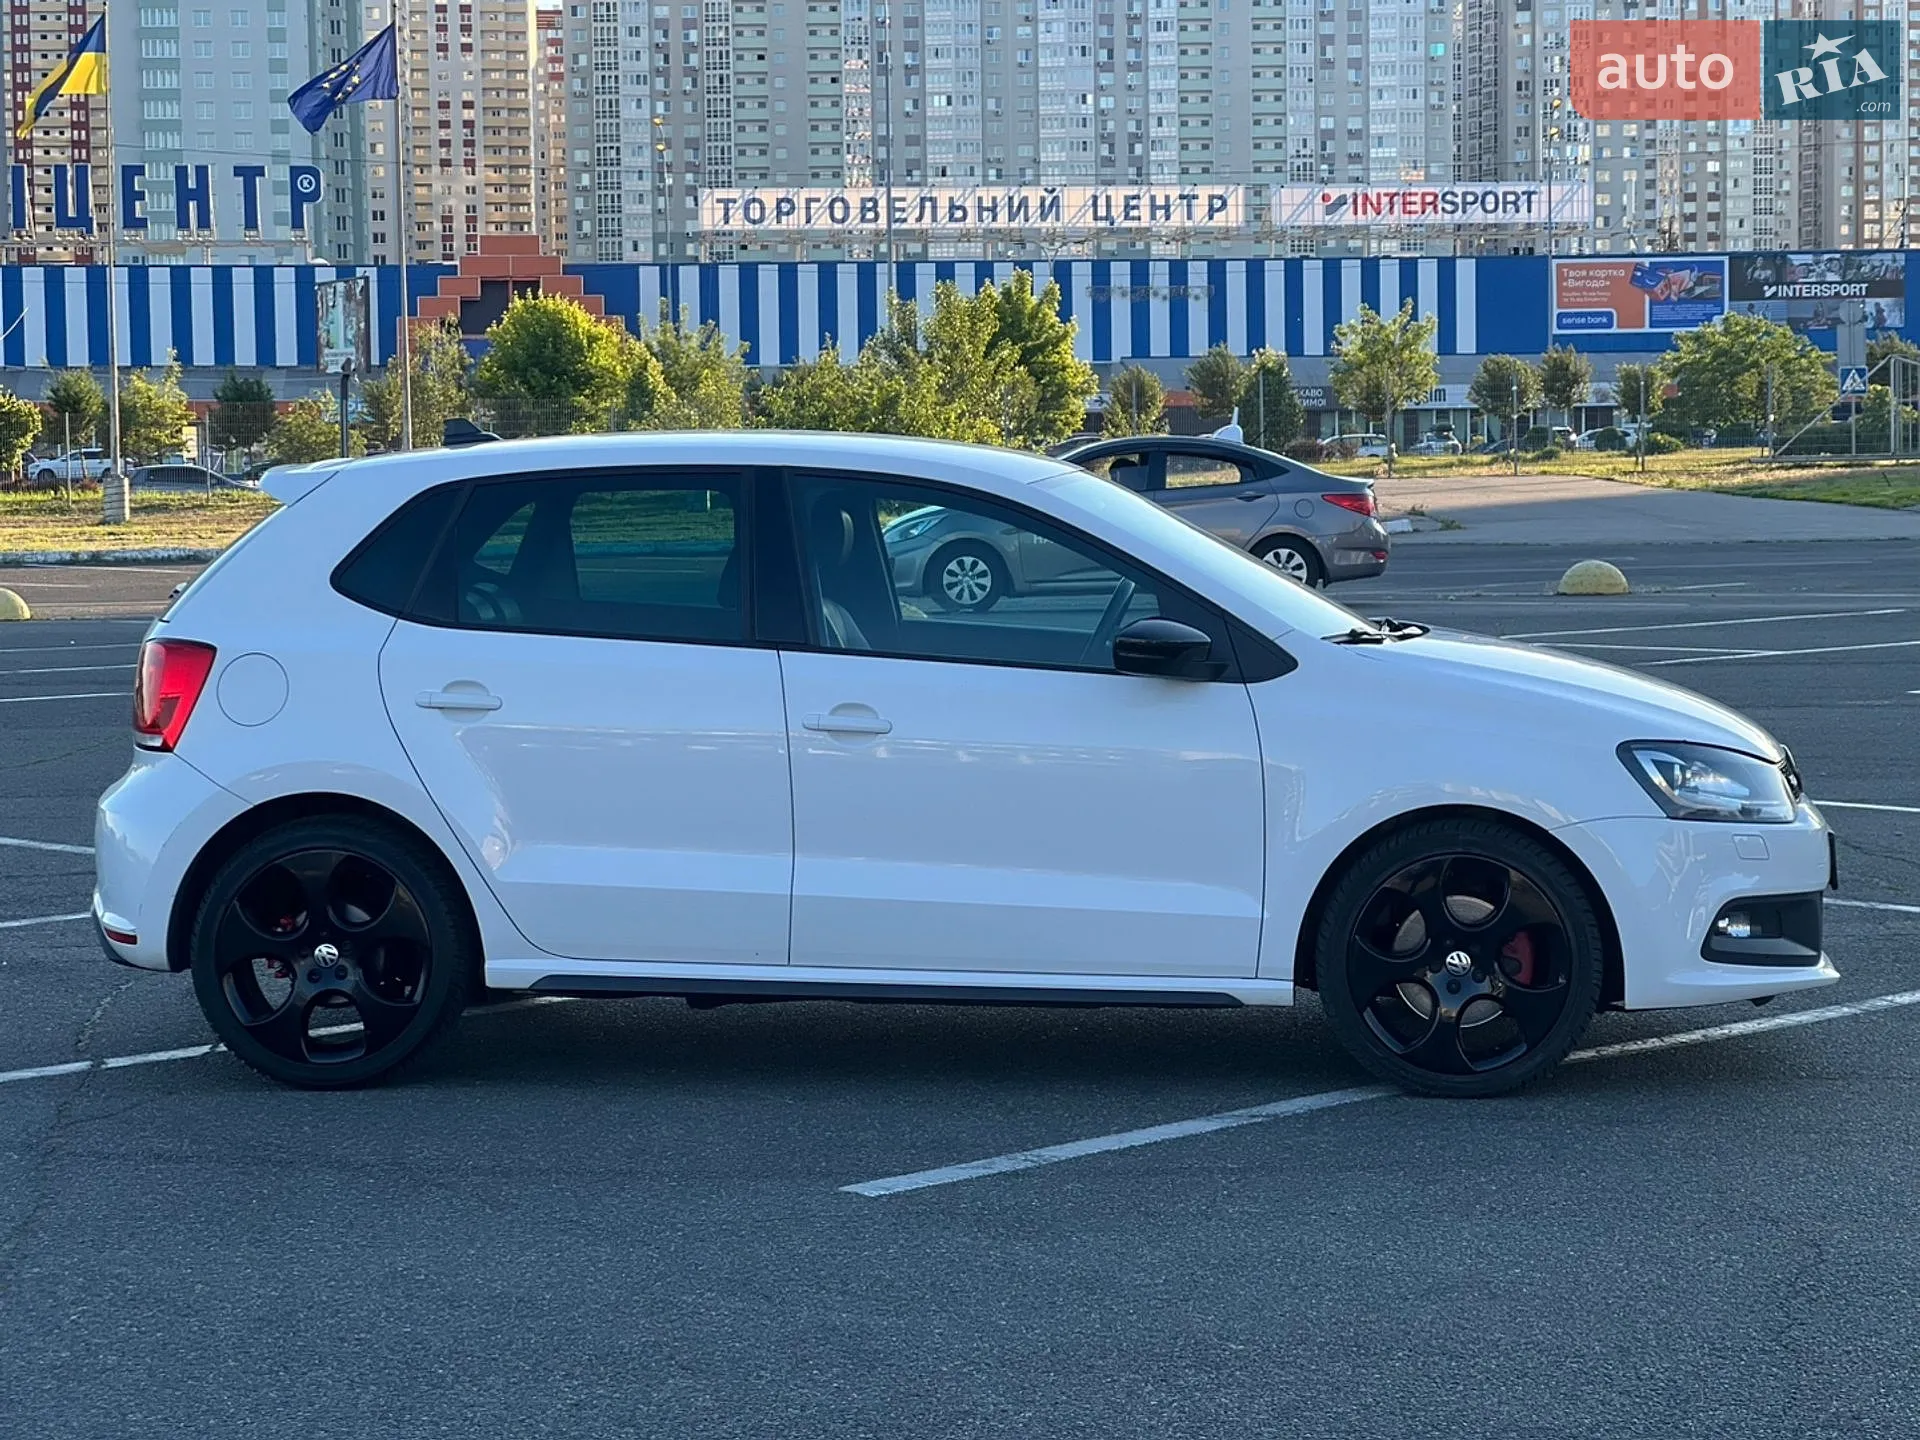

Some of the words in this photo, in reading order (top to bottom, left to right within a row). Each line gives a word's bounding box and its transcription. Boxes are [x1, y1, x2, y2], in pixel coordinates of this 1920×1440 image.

[715, 187, 1062, 226] ТОРГОВЕЛЬНИЙ
[1091, 193, 1229, 227] ЦЕНТР
[1352, 190, 1539, 216] INTERSPORT
[1562, 268, 1587, 278] Твоя
[1589, 269, 1626, 279] картка
[1562, 279, 1611, 288] «Вигода»
[1778, 283, 1868, 297] INTERSPORT
[1587, 316, 1609, 324] bank
